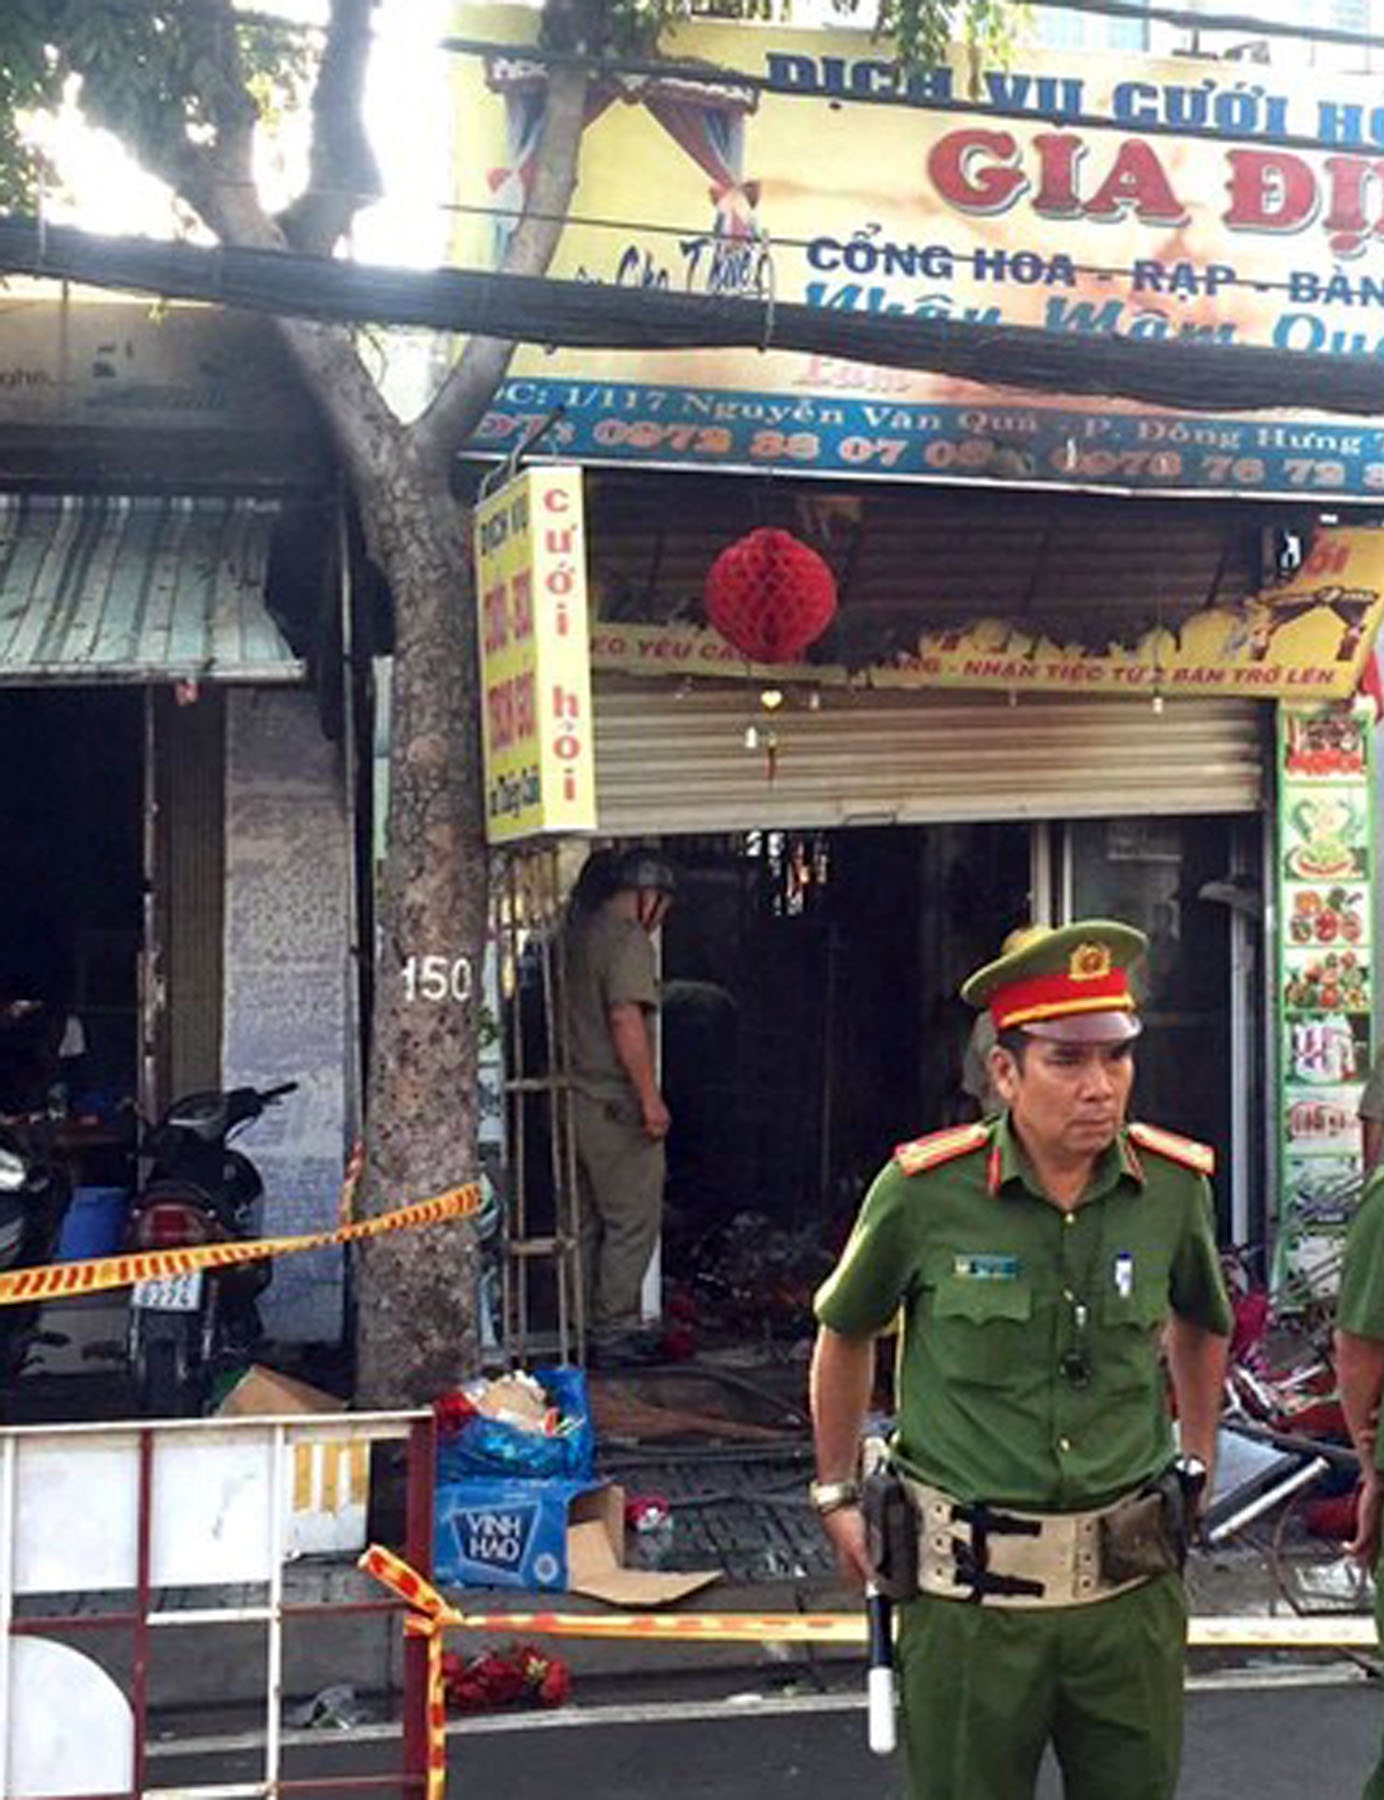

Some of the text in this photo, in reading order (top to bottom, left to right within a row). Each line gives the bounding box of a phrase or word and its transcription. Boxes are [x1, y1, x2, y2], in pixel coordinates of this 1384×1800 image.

[928, 129, 1190, 229] GIA
[806, 223, 953, 280] CỔNG
[973, 247, 1077, 288] HOA
[1133, 259, 1237, 301] RẠP
[401, 955, 472, 1002] 150
[466, 1513, 521, 1538] VINH
[469, 1538, 520, 1561] HAO
